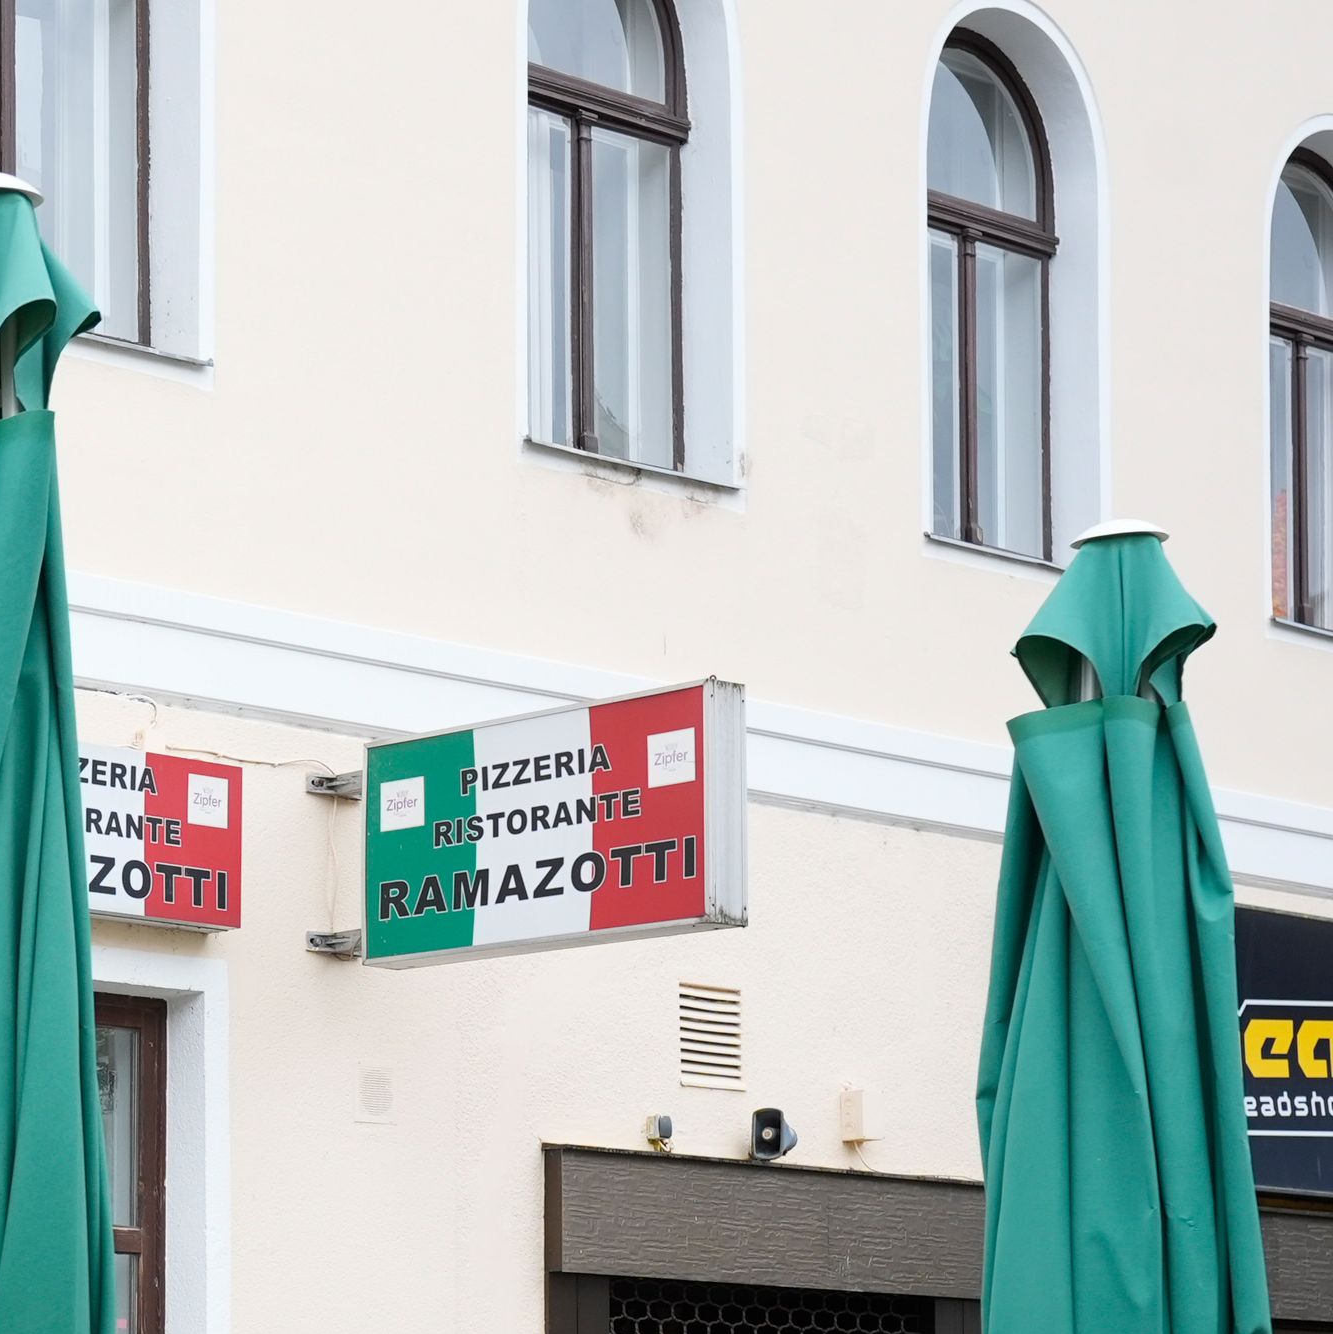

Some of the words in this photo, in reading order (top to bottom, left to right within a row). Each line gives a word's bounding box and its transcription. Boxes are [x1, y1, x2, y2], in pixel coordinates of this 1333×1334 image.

[459, 744, 612, 797] PIZZERIA
[653, 748, 689, 768] Zipfer
[192, 792, 222, 808] Zipfer
[385, 795, 419, 813] Zipfer
[433, 788, 641, 848] RISTORANTE
[85, 807, 182, 847] RANTE
[88, 854, 228, 911] ZOTTI
[379, 836, 696, 921] RAMAZOTTI
